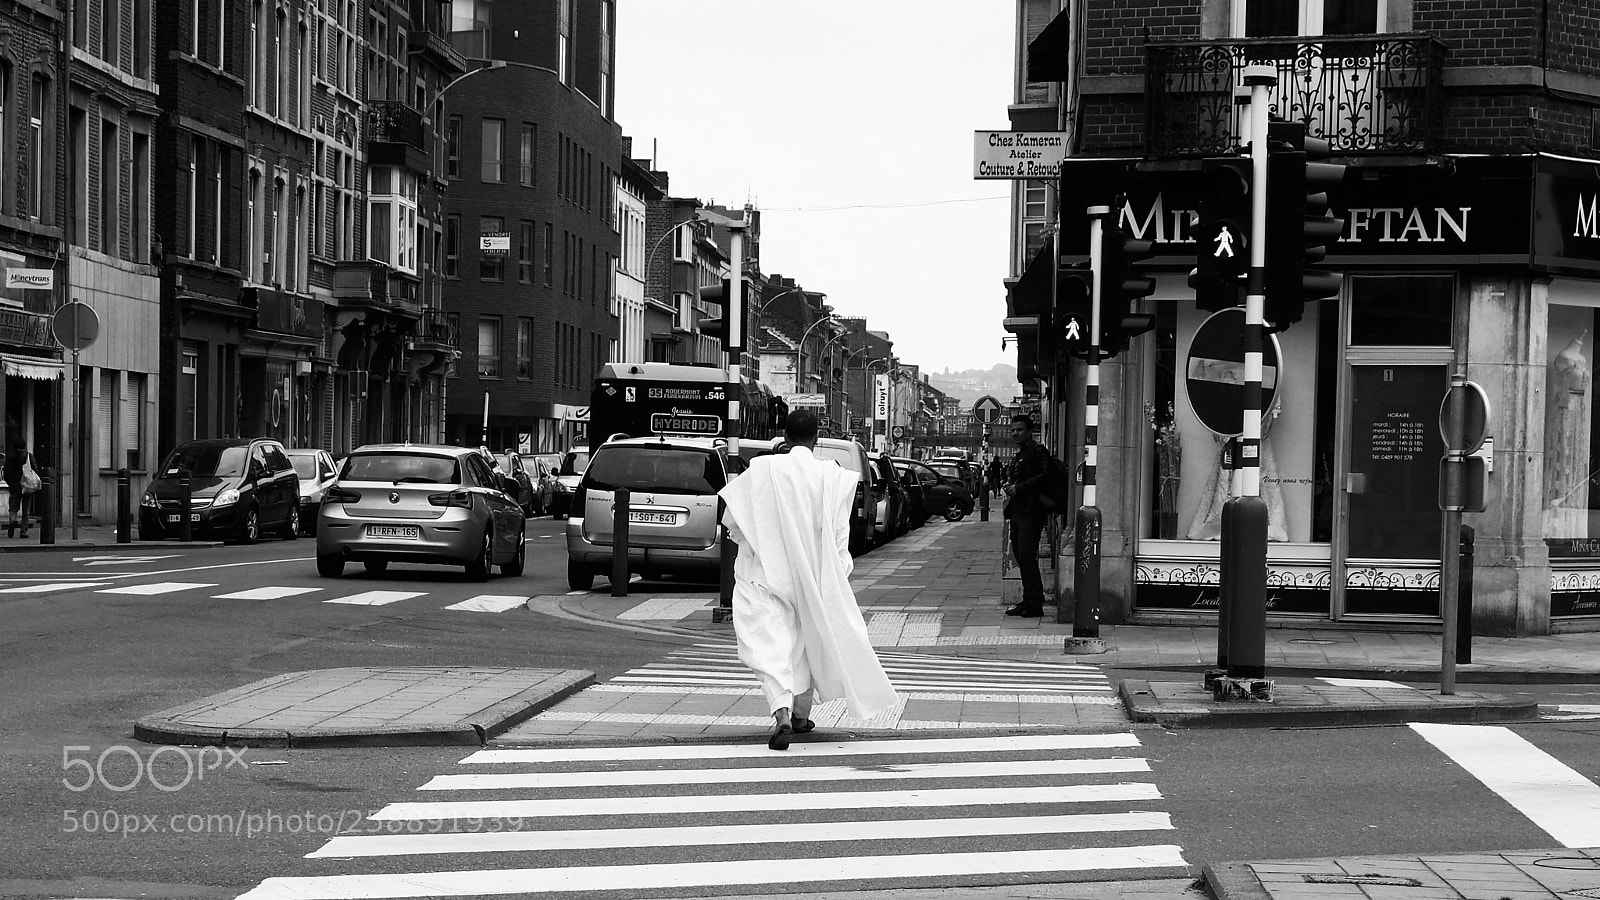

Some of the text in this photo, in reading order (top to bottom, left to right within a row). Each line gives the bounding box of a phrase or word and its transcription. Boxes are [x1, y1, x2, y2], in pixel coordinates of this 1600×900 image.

[988, 133, 1062, 147] Chez Kameran
[1009, 149, 1042, 159] Atelier
[979, 160, 1015, 176] Couture
[1017, 161, 1025, 176] &
[649, 388, 663, 398] 35
[877, 388, 888, 416] colruyt
[654, 418, 717, 431] HYBRIDE
